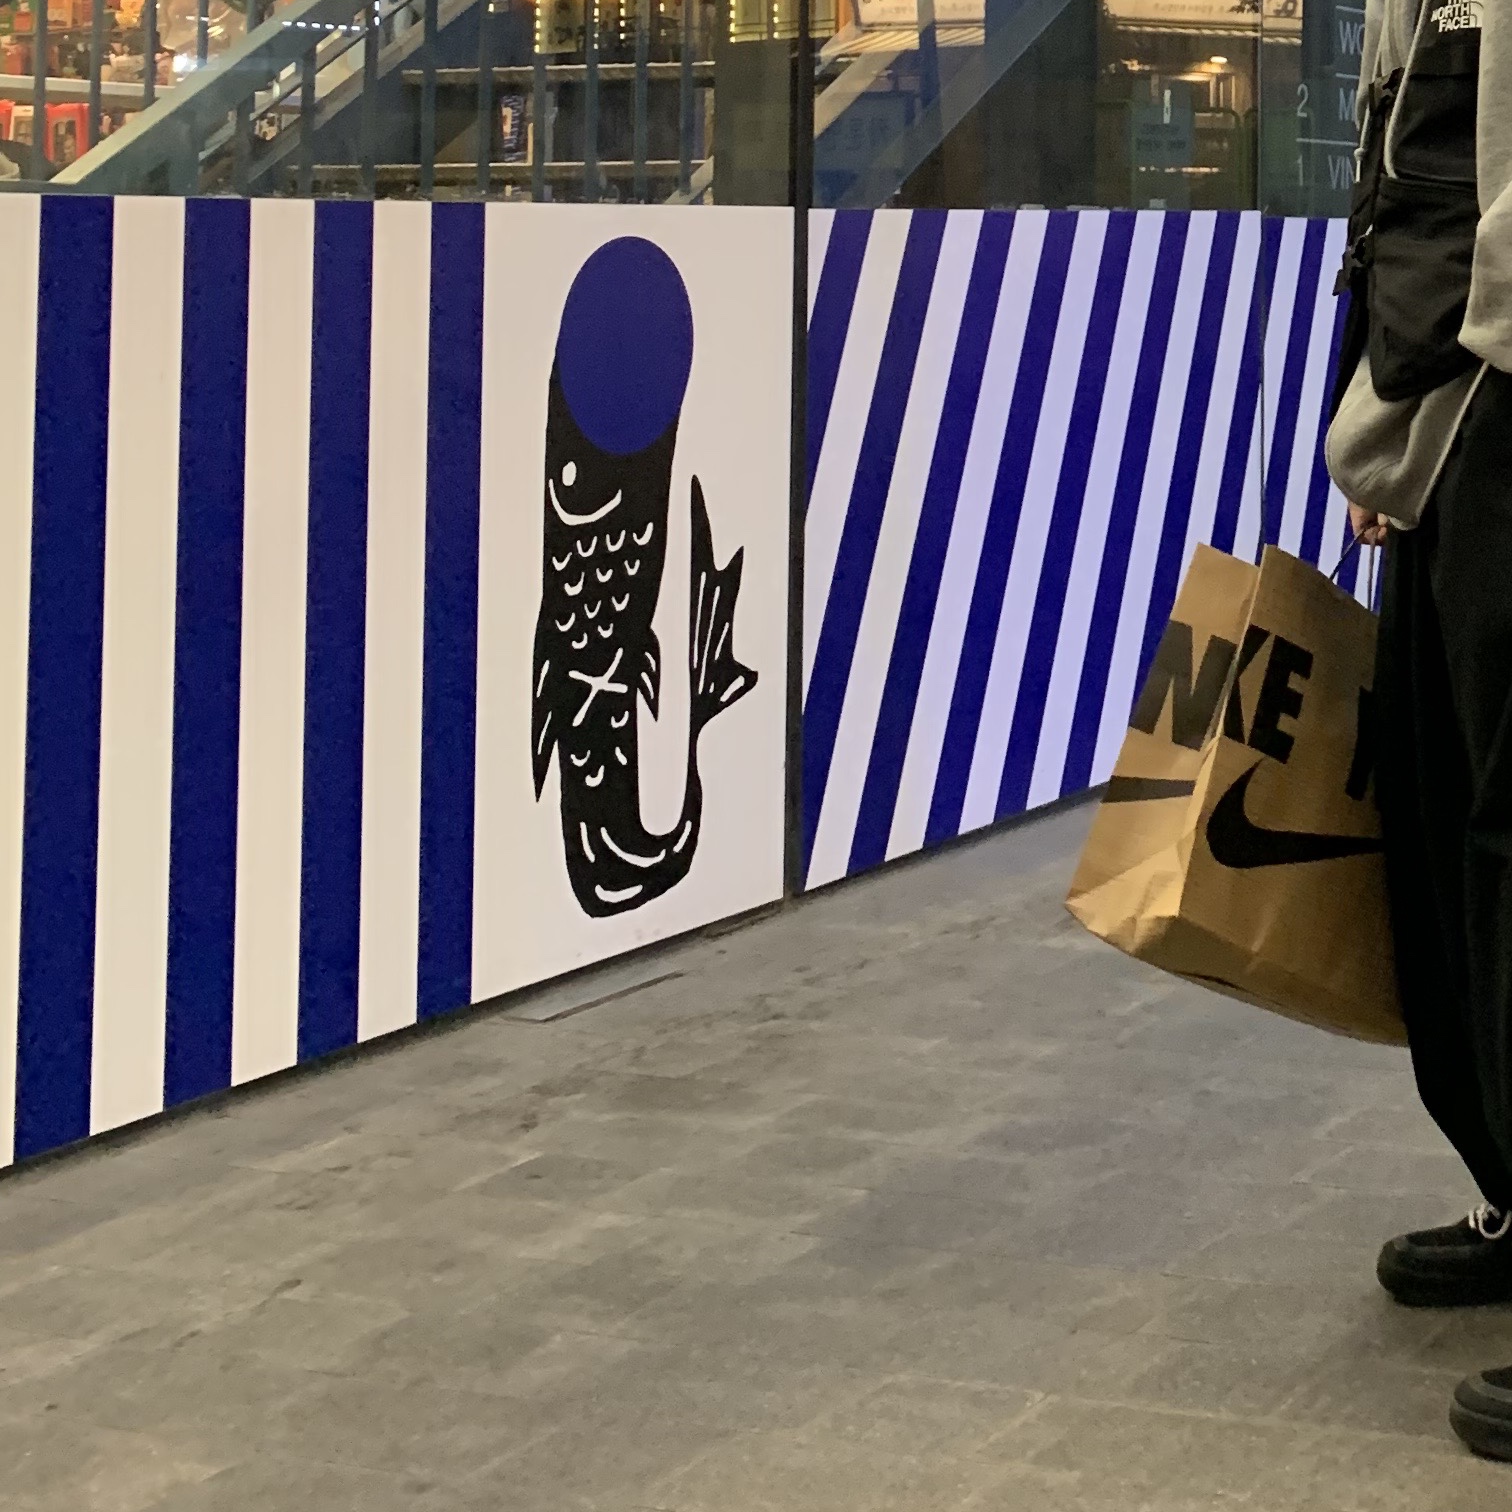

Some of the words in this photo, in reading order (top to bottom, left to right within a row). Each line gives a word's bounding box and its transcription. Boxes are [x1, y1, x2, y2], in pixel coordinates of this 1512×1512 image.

[1430, 2, 1470, 22] NORTH
[1438, 15, 1470, 33] FACE
[1296, 84, 1309, 118] 2
